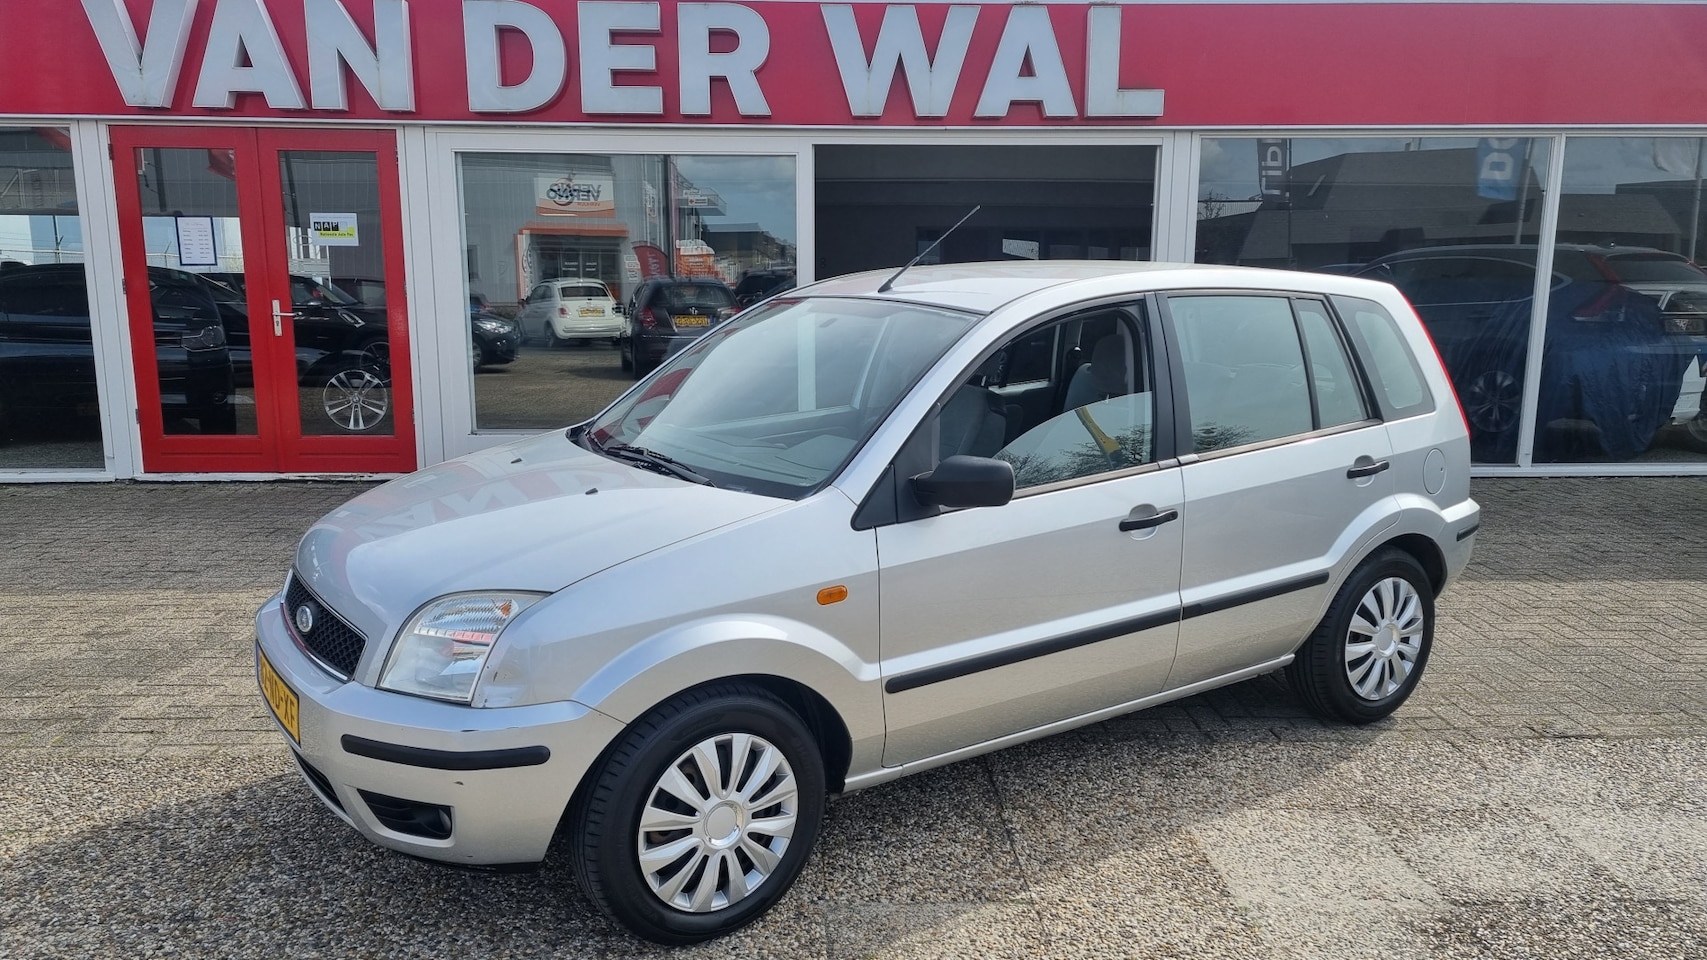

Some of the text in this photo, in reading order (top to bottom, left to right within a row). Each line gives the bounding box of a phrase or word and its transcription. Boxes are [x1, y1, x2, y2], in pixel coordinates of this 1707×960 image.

[80, 0, 1166, 119] VAN DER WAL
[314, 221, 339, 231] NAP
